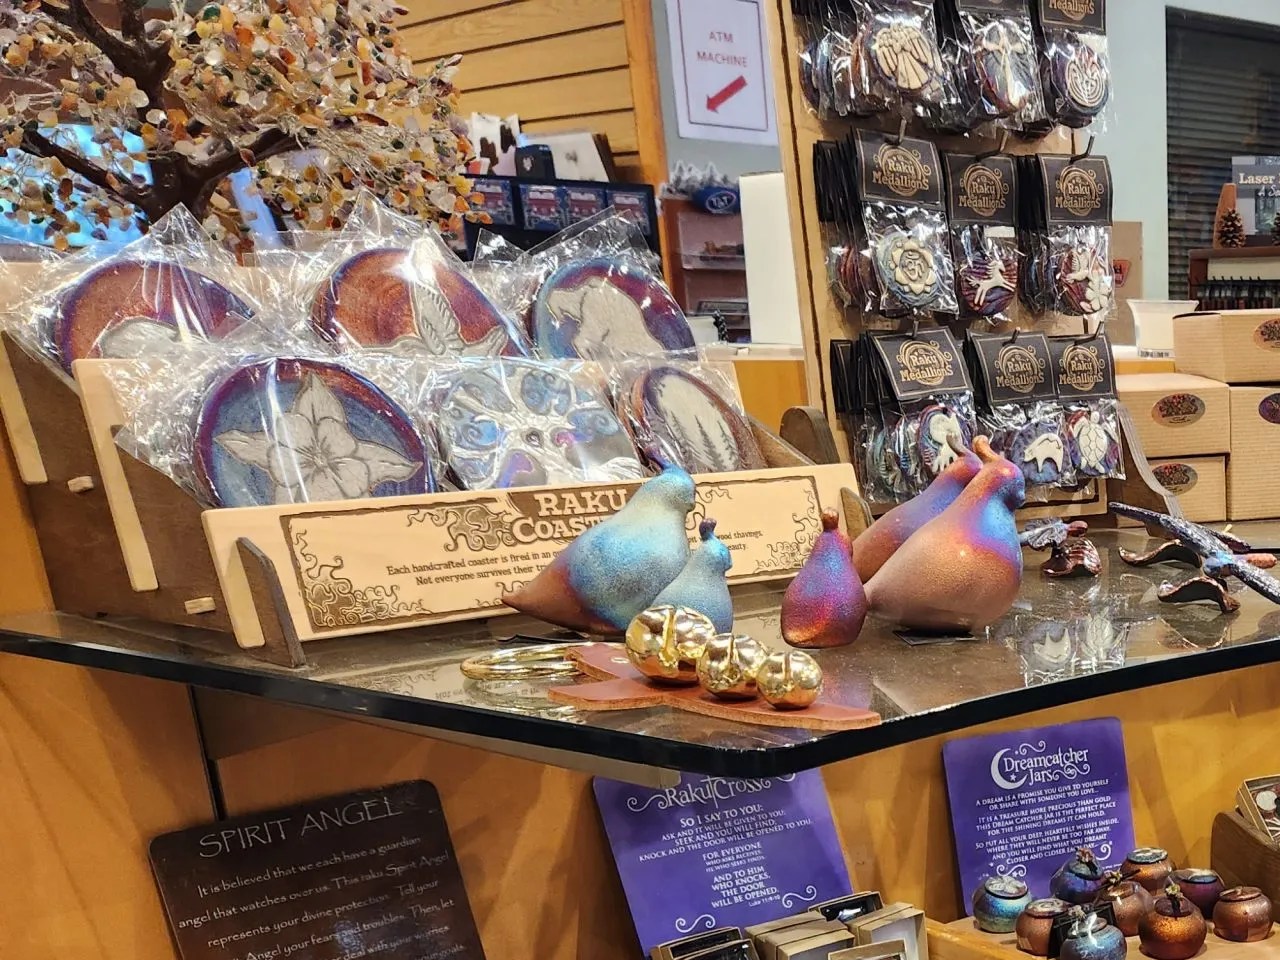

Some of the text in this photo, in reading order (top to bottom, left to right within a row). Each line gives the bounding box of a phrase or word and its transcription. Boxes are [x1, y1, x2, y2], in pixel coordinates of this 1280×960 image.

[709, 31, 734, 43] ATM
[696, 51, 748, 67] MACHINE
[888, 160, 915, 177] Raku
[872, 169, 929, 191] Medallions
[1239, 173, 1275, 184] Laser
[972, 181, 995, 195] Raku
[1068, 181, 1090, 195] Raku
[1258, 186, 1265, 197] A
[959, 196, 1006, 209] Medallions
[1055, 195, 1101, 209] Medallions
[910, 354, 937, 371] Raku
[1007, 360, 1031, 373] Raku
[1071, 360, 1092, 373] Raku
[900, 365, 953, 382] Medallions
[996, 372, 1044, 388] Medallions
[1059, 372, 1103, 385] Medallions
[534, 489, 627, 516] RAKU
[512, 517, 606, 543] COAST
[386, 565, 411, 576] Each
[412, 560, 466, 573] handcrafted
[467, 557, 498, 567] coaster
[510, 552, 531, 562] fired
[416, 565, 533, 586] Not everyone survives their
[1004, 747, 1089, 773] Dreamcatcher
[1029, 769, 1054, 786] Jars
[664, 779, 764, 808] Raku Cross
[982, 796, 1003, 805] DREAM
[1018, 790, 1043, 800] PROMISE
[1081, 779, 1109, 788] YOURSELF
[680, 817, 695, 828] SO
[705, 812, 721, 823] SAY
[724, 808, 738, 819] TO
[200, 797, 404, 858] SPIRIT ANGEL
[702, 841, 763, 861] FOR EVERYONE
[198, 885, 208, 898] It
[210, 883, 220, 893] is
[222, 869, 271, 890] believed
[273, 866, 297, 878] that
[299, 863, 313, 873] we
[315, 854, 341, 867] each
[343, 850, 367, 862] have
[378, 836, 421, 856] guardian
[720, 881, 767, 898] THE DOOR
[178, 910, 211, 929] angel
[213, 906, 238, 920] that
[240, 895, 287, 913] watches
[289, 887, 312, 900] over
[331, 876, 360, 890] This
[361, 868, 383, 881] raku
[711, 898, 733, 909] WILL
[734, 893, 743, 901] BE
